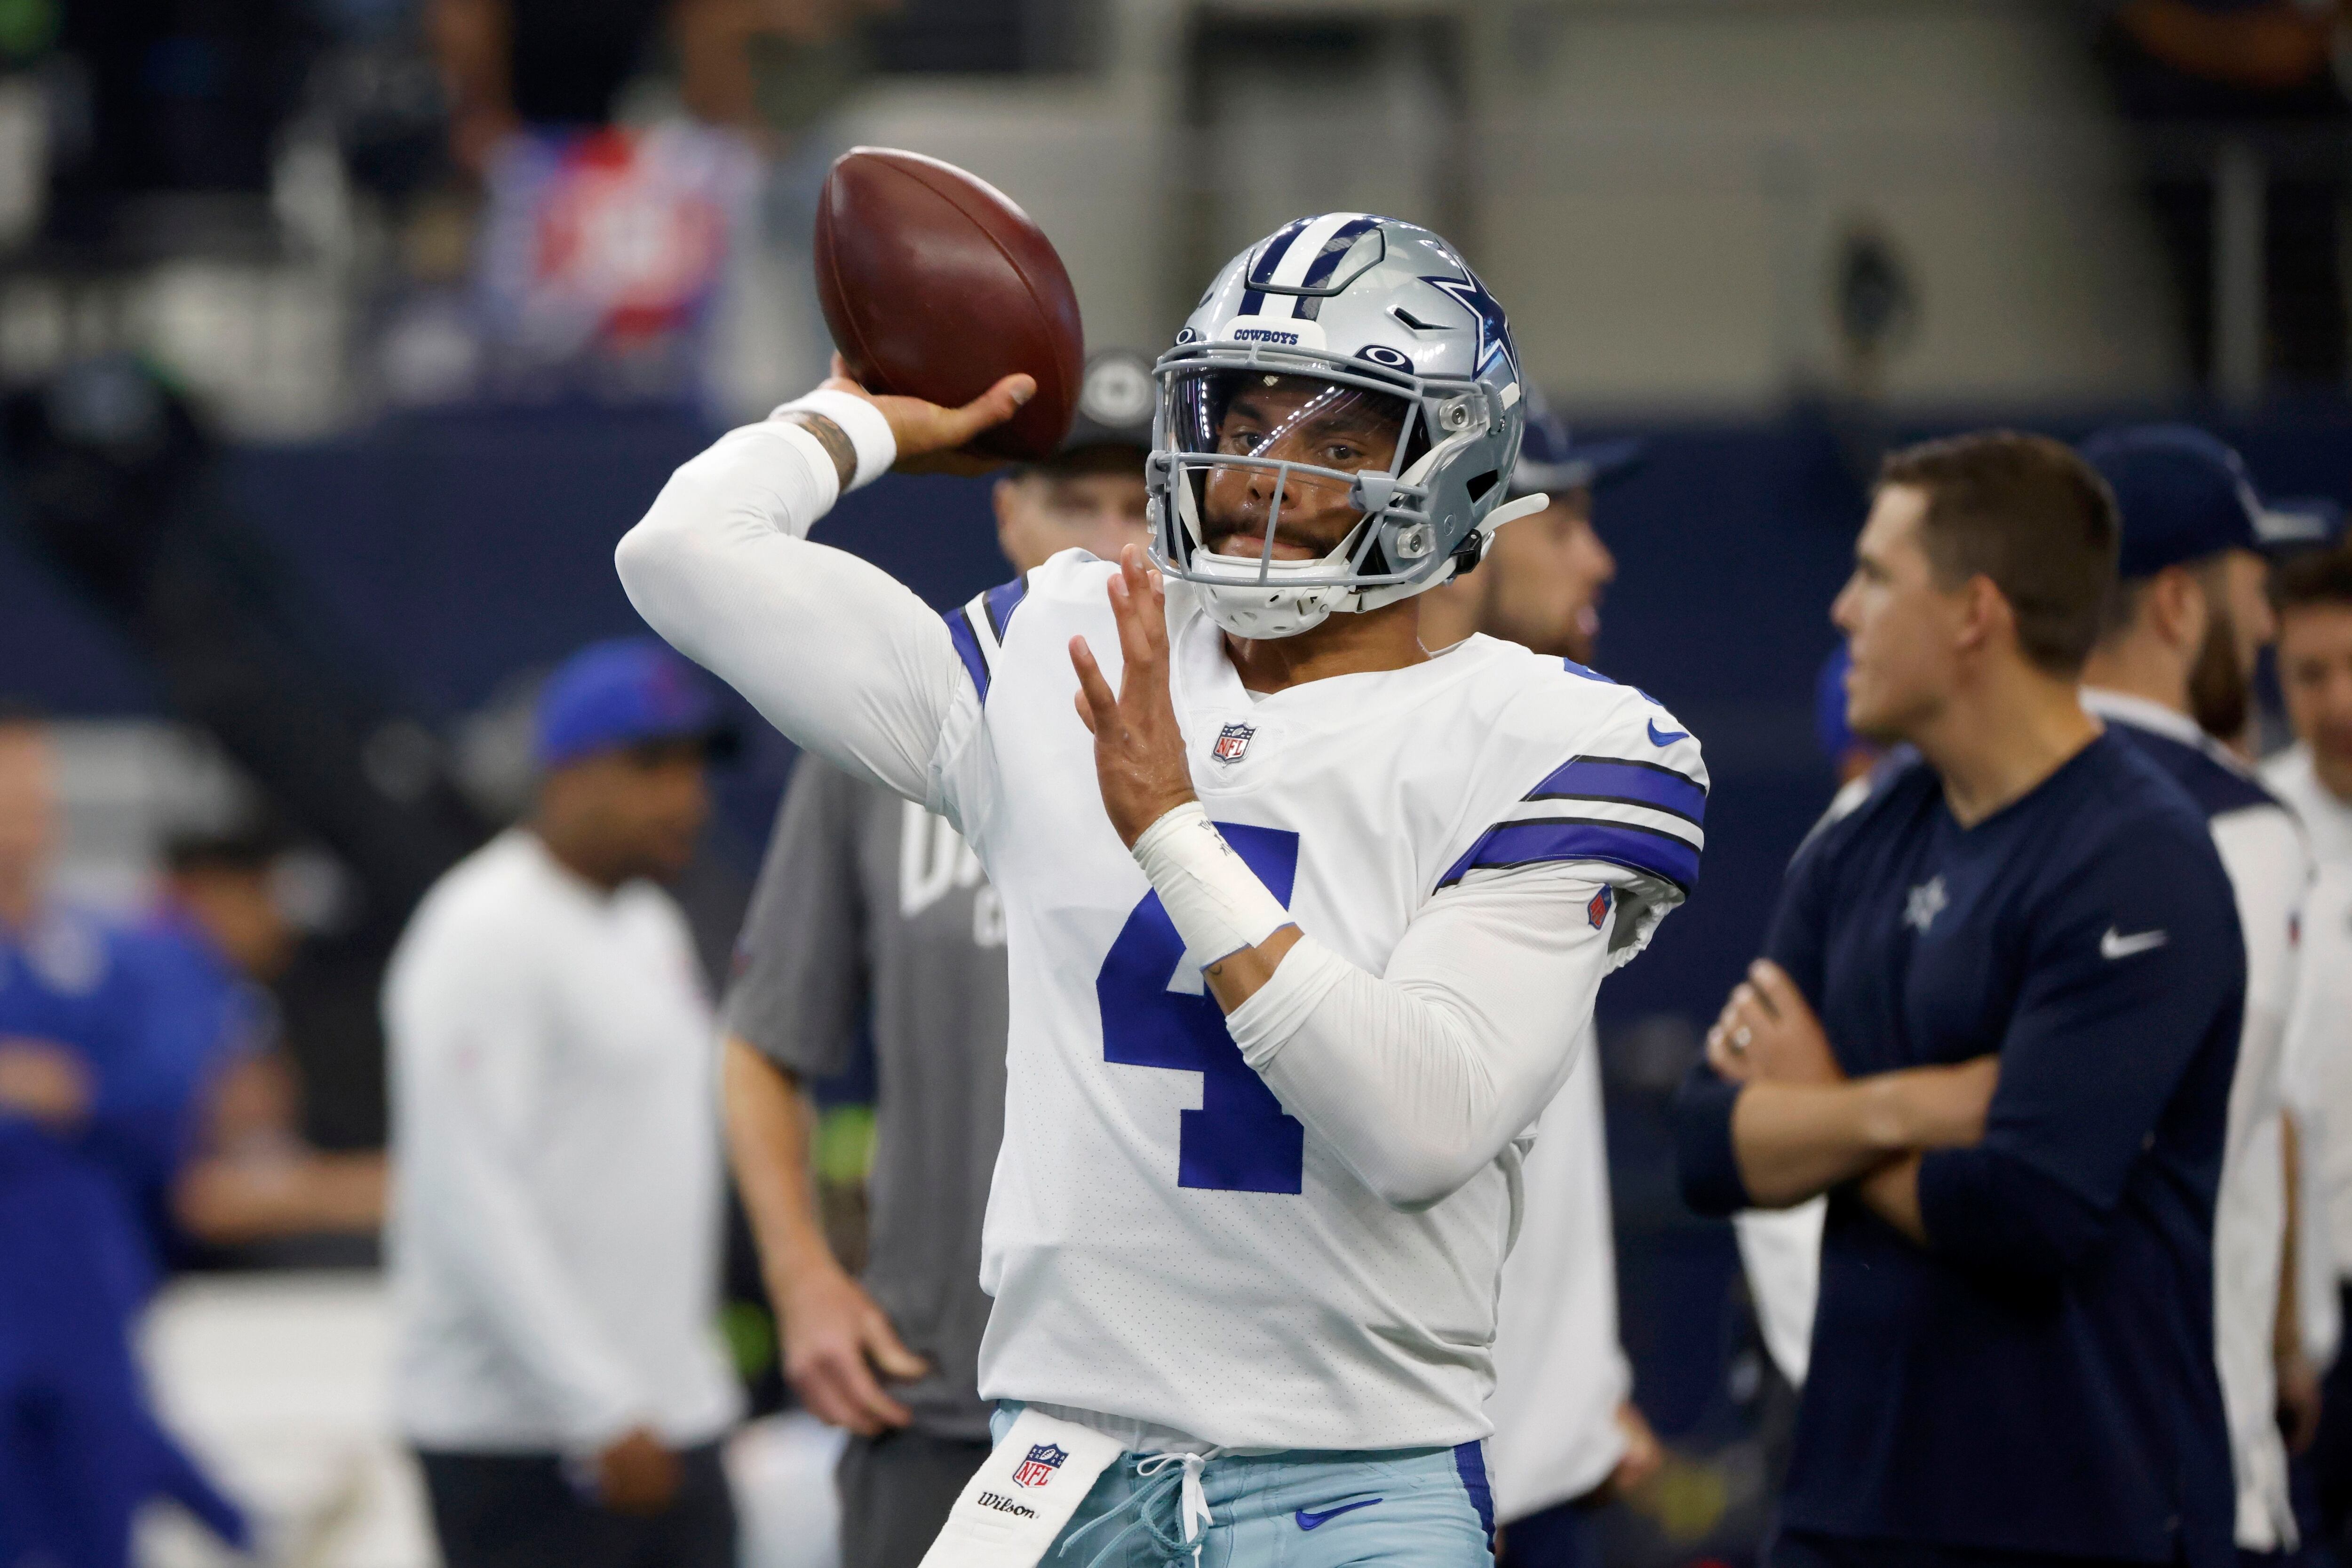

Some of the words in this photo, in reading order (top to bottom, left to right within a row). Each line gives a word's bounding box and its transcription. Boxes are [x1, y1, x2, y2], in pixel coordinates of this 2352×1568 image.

[1234, 329, 1299, 345] COWBOYS
[1216, 738, 1243, 757] NFL
[1096, 821, 1304, 1195] 4
[1016, 1461, 1052, 1486] NFL
[977, 1492, 1035, 1519] Wilson
